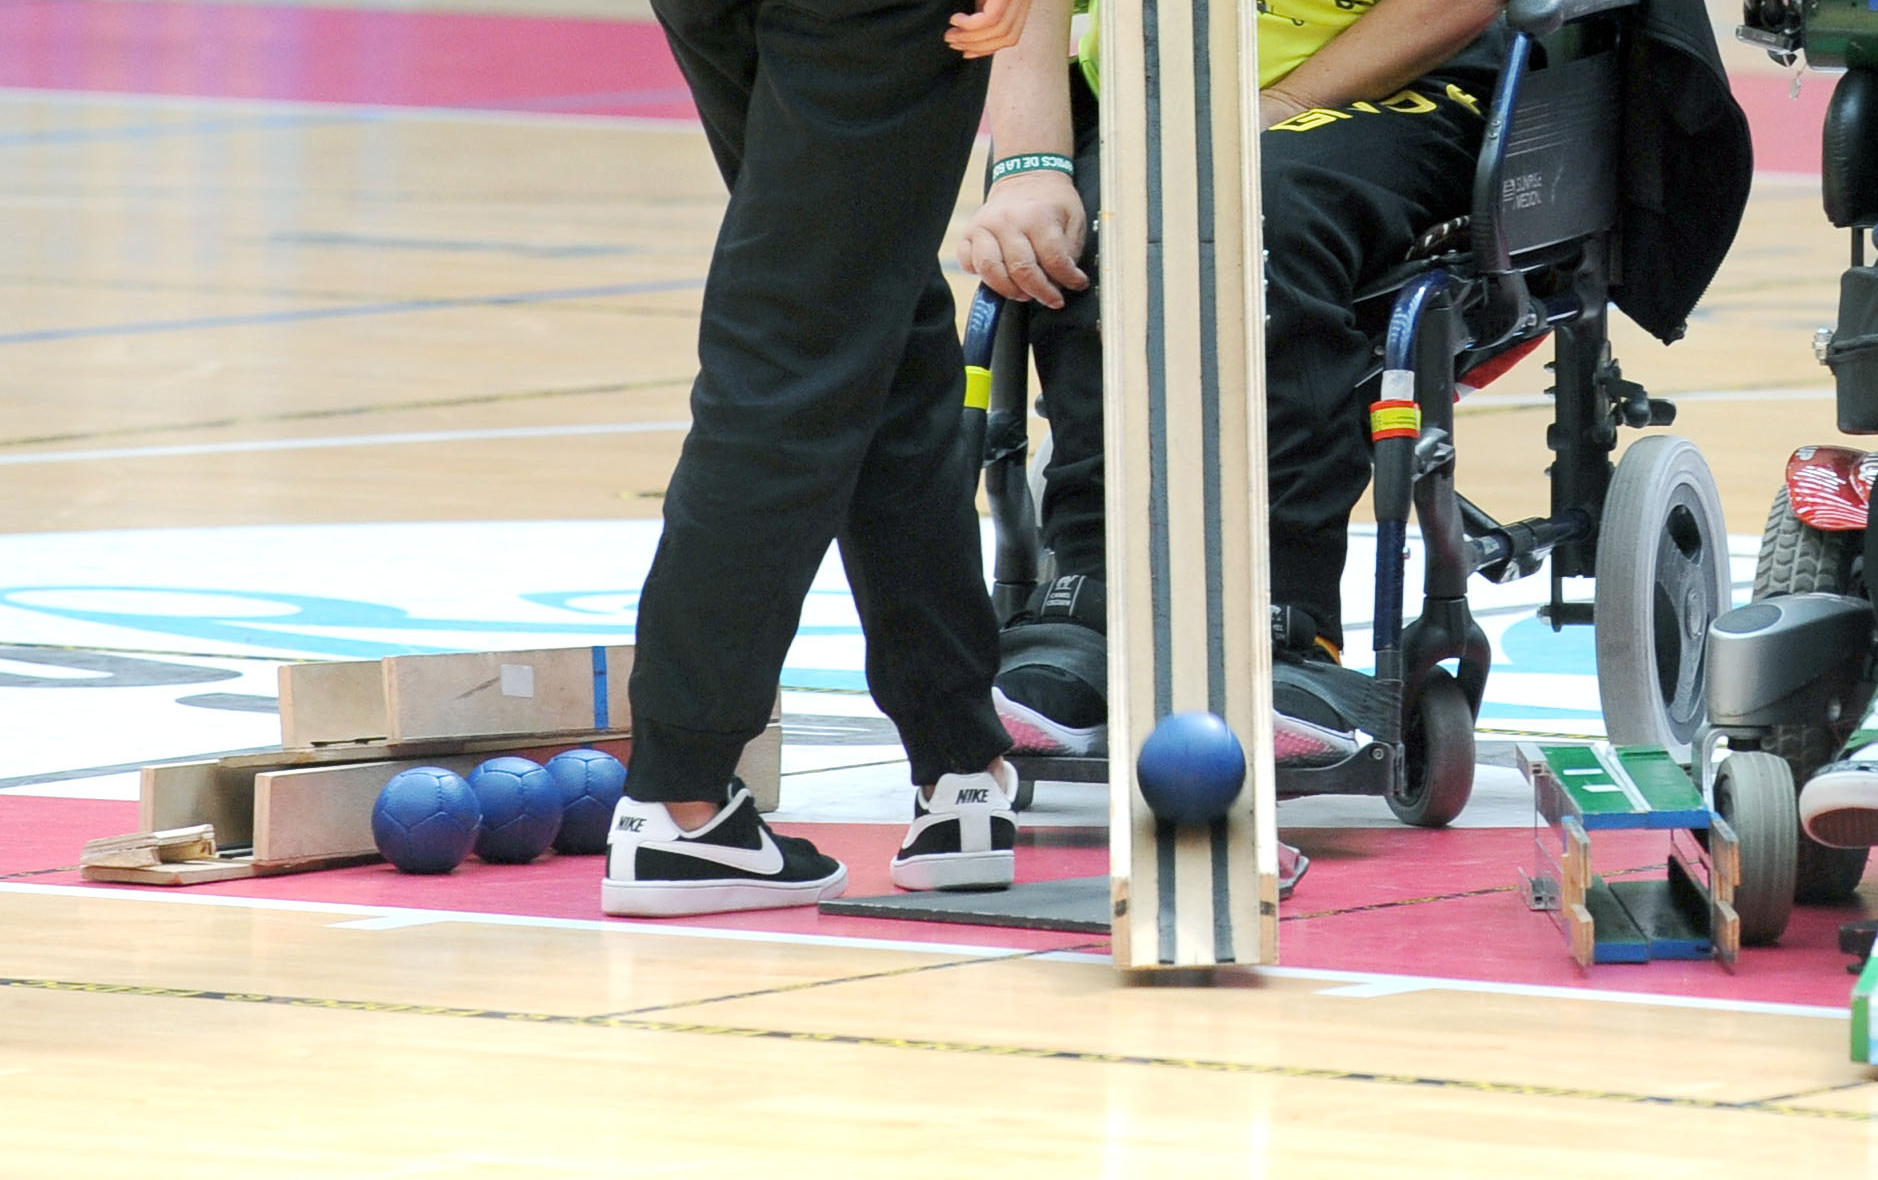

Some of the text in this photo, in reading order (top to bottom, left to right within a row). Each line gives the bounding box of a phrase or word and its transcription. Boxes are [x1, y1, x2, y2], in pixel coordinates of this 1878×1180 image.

[1006, 158, 1021, 171] LA
[1022, 156, 1040, 168] DE
[955, 788, 990, 804] NIKE
[618, 816, 648, 832] NIKE
